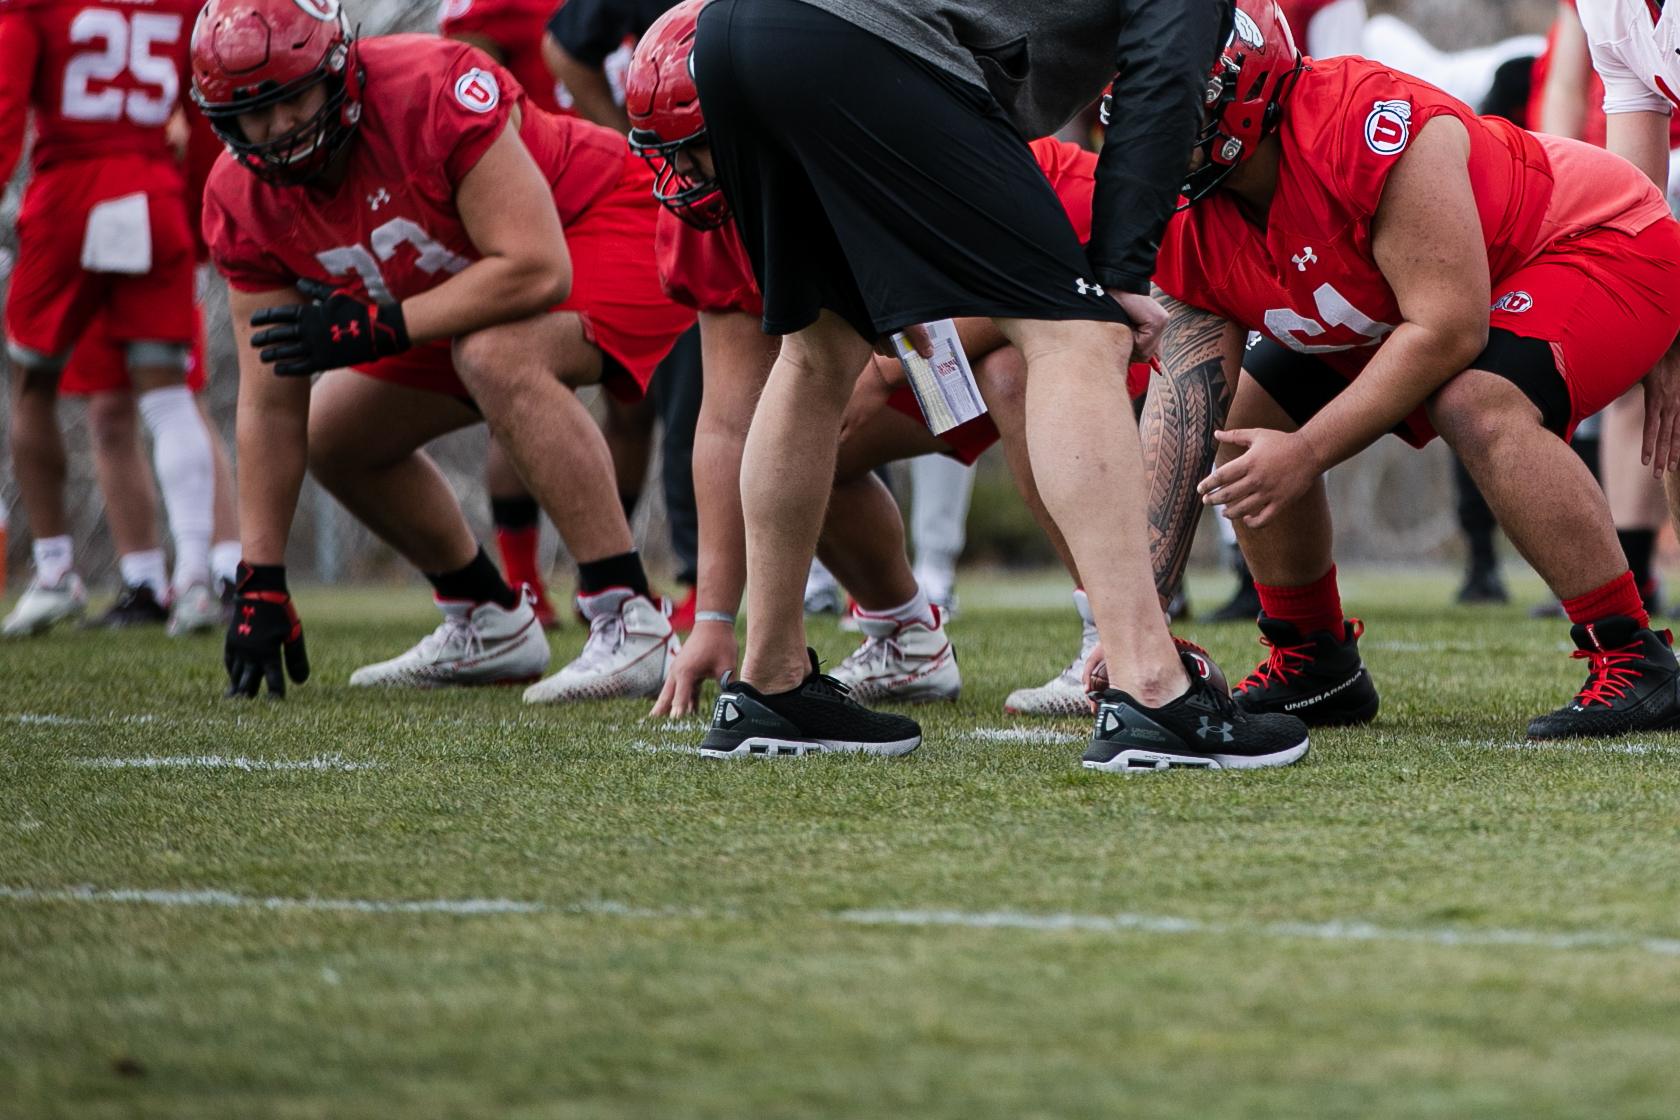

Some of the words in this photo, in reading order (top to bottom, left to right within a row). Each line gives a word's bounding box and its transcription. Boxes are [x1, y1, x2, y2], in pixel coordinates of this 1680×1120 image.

[61, 8, 183, 126] 25
[464, 81, 490, 104] U
[1373, 114, 1403, 145] U
[1506, 295, 1529, 311] U
[1284, 695, 1322, 711] UNDER
[1323, 670, 1362, 699] ARMOUR
